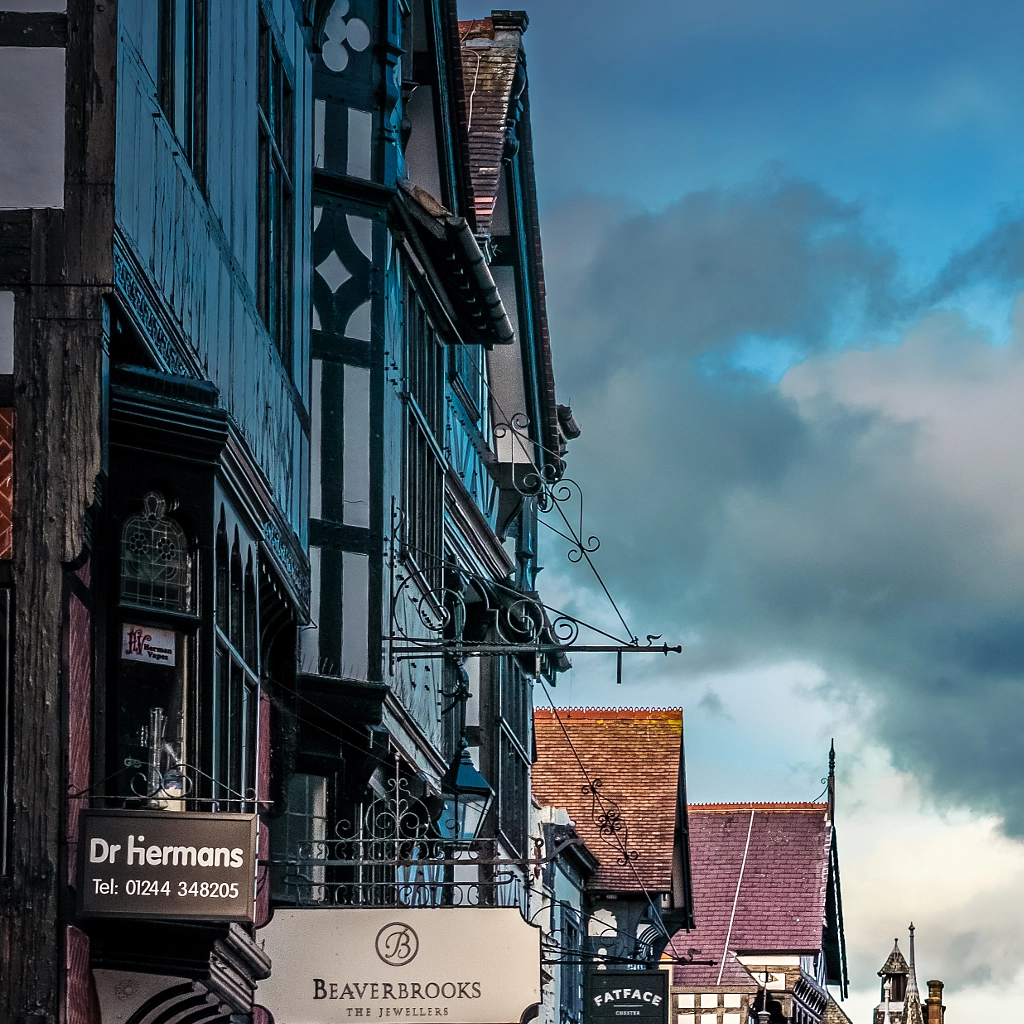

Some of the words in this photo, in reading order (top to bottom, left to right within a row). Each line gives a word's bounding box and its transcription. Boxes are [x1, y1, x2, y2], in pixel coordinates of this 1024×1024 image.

[144, 644, 172, 655] Herman
[147, 650, 168, 661] Vapes
[89, 837, 121, 864] Dr
[92, 878, 118, 895] Tel:
[125, 879, 171, 897] 01244
[177, 881, 239, 899] 348205
[312, 978, 482, 1001] BEAVERBROOKS
[593, 988, 663, 1008] FATFACE
[346, 1007, 372, 1017] THE
[378, 1007, 449, 1018] JEWELLERS
[615, 1009, 641, 1017] CHESTER
